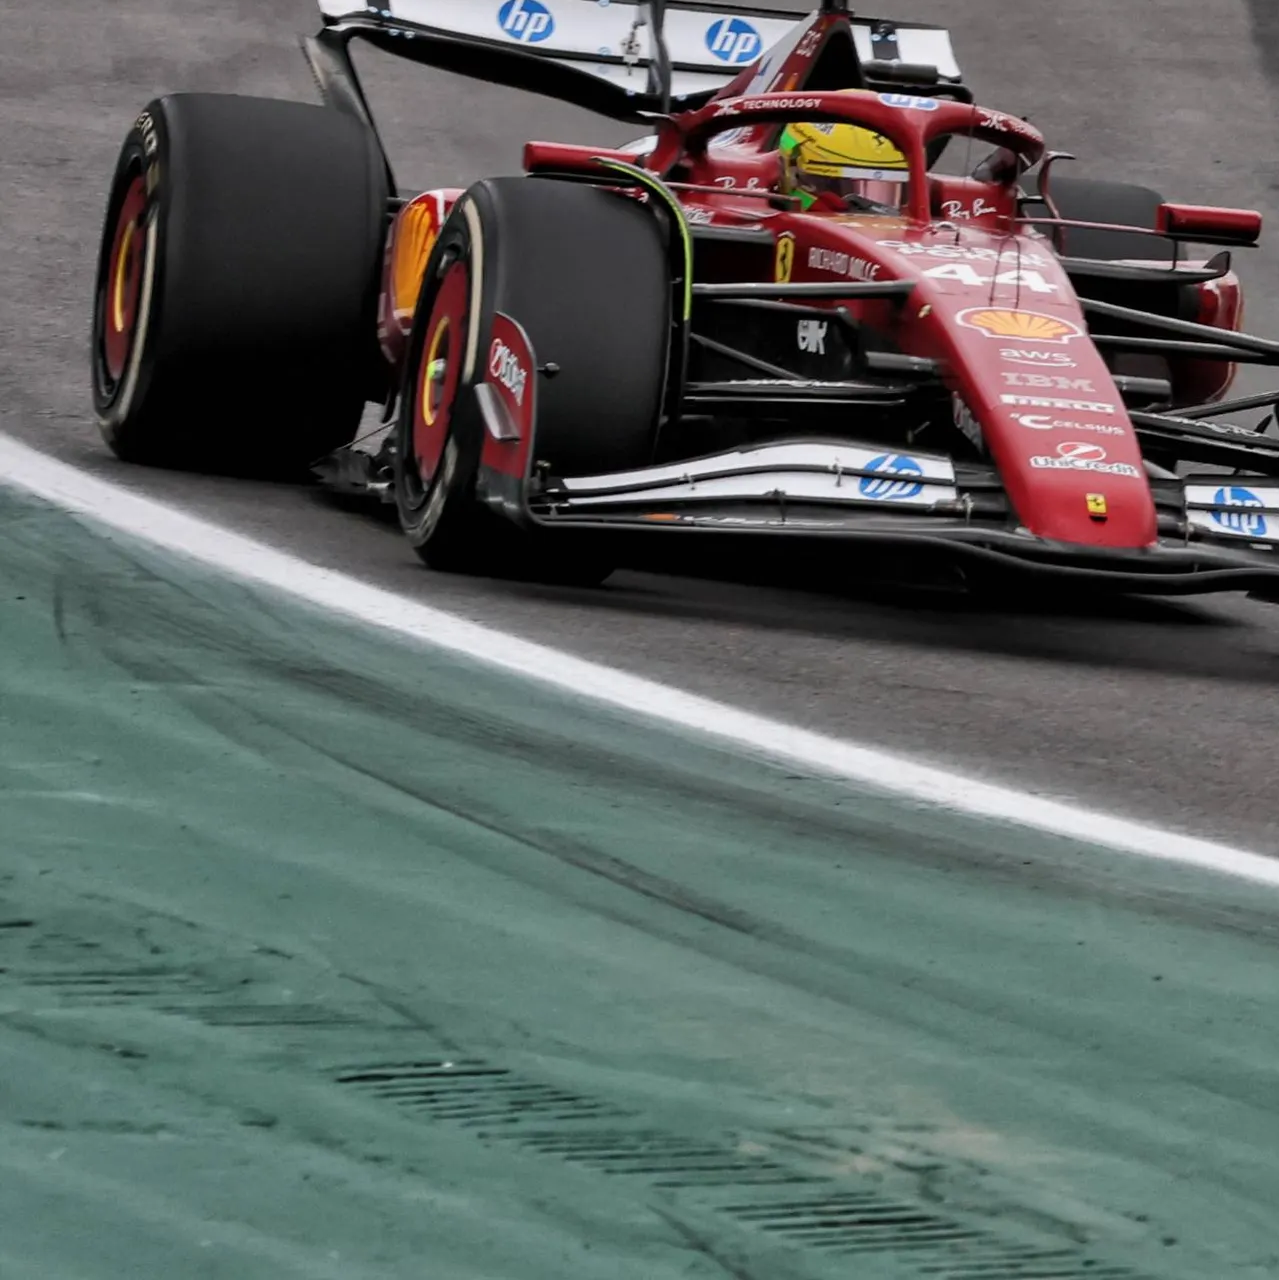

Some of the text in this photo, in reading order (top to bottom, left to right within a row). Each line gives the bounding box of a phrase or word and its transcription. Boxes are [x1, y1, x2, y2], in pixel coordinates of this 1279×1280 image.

[711, 18, 756, 64] hp
[743, 98, 822, 110] TECHNOLOGY
[808, 247, 849, 275] RICHARD
[848, 256, 881, 281] MILLE
[922, 263, 1059, 293] 44
[999, 348, 1072, 364] aws
[1000, 372, 1097, 392] IBM
[1052, 419, 1126, 436] CELSIUS
[864, 453, 922, 500] hp
[1032, 457, 1140, 479] UniCredit
[1218, 486, 1264, 536] hp
